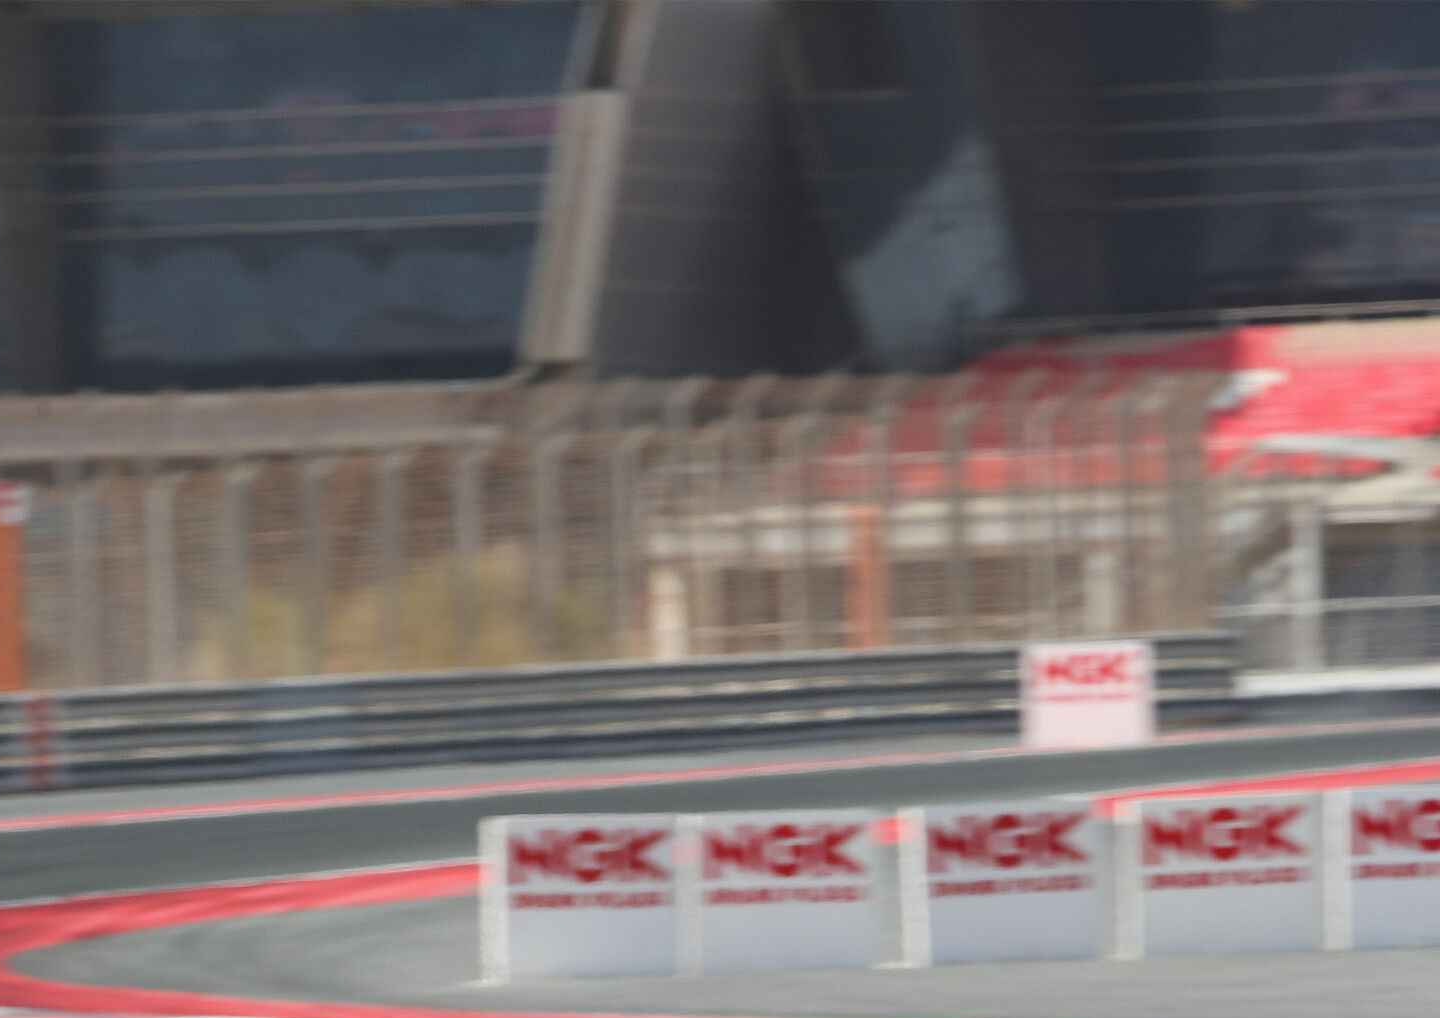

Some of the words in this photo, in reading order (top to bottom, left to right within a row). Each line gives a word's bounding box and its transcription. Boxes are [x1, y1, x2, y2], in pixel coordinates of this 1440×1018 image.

[507, 826, 673, 884] NGK
[702, 823, 868, 880] NGK
[926, 812, 1093, 873] NGK
[1142, 804, 1310, 865] NGK
